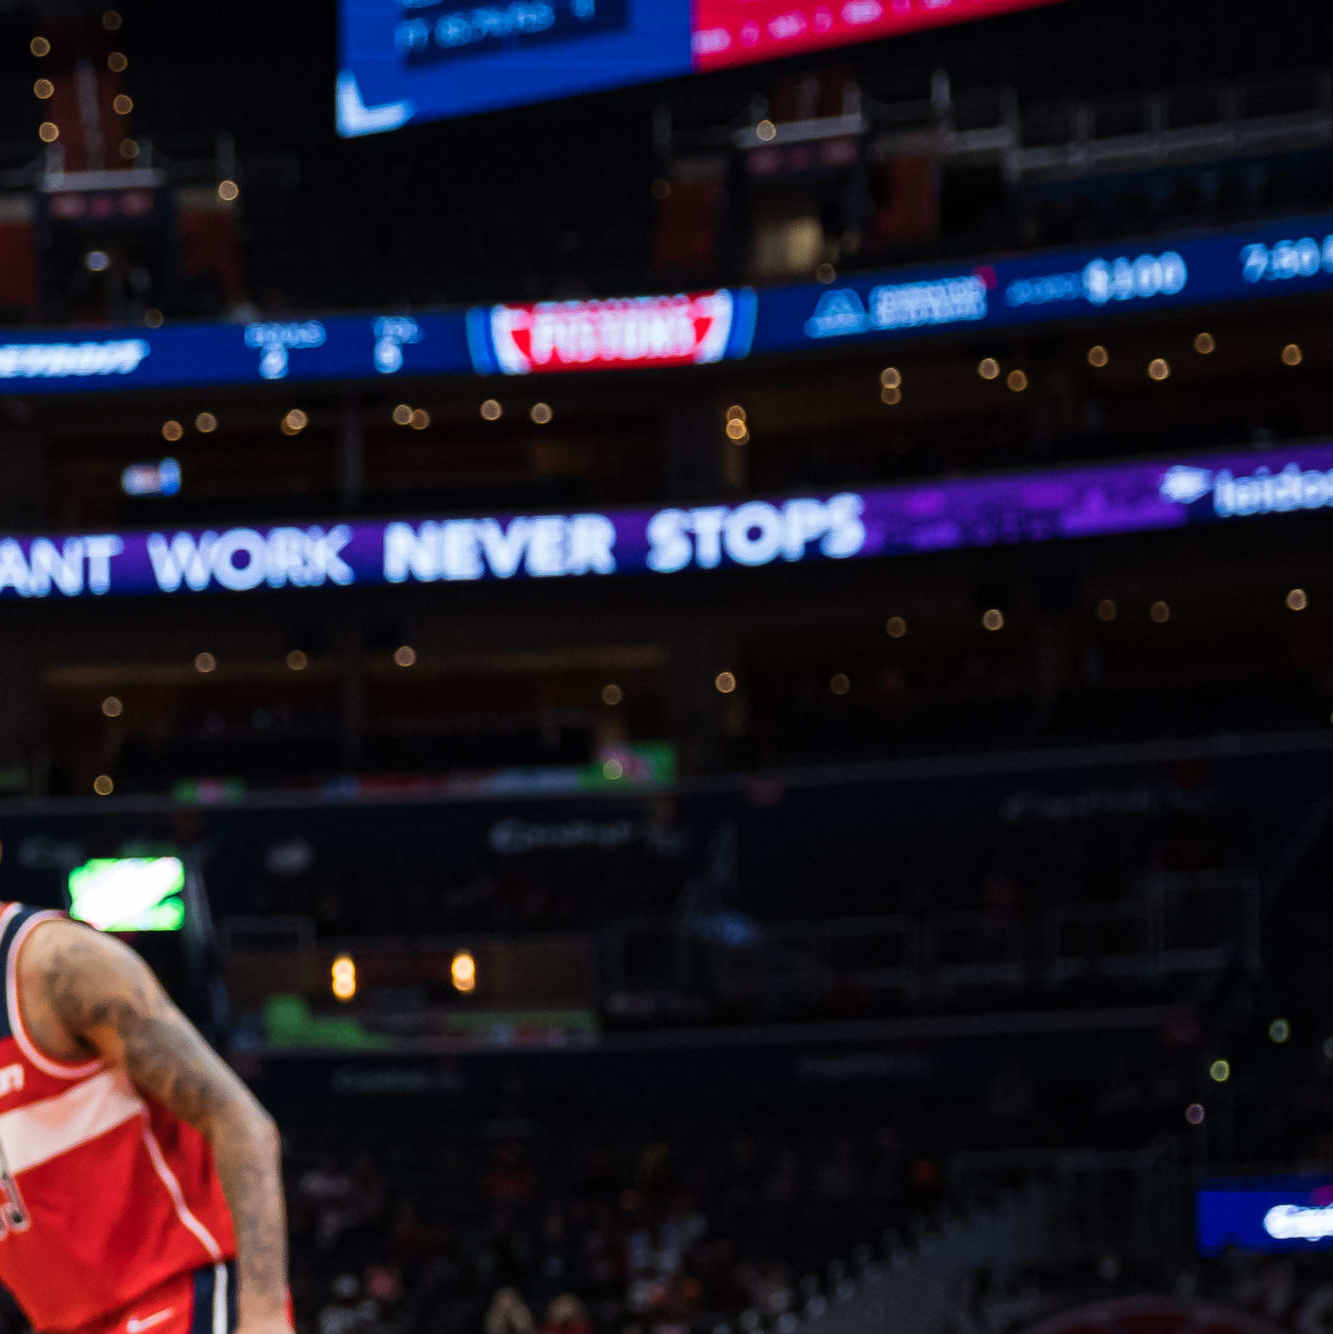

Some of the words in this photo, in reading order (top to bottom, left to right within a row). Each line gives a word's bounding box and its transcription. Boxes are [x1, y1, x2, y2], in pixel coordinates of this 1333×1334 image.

[147, 524, 354, 593] WORK
[382, 513, 618, 584] NEVER
[647, 492, 867, 573] STOPS
